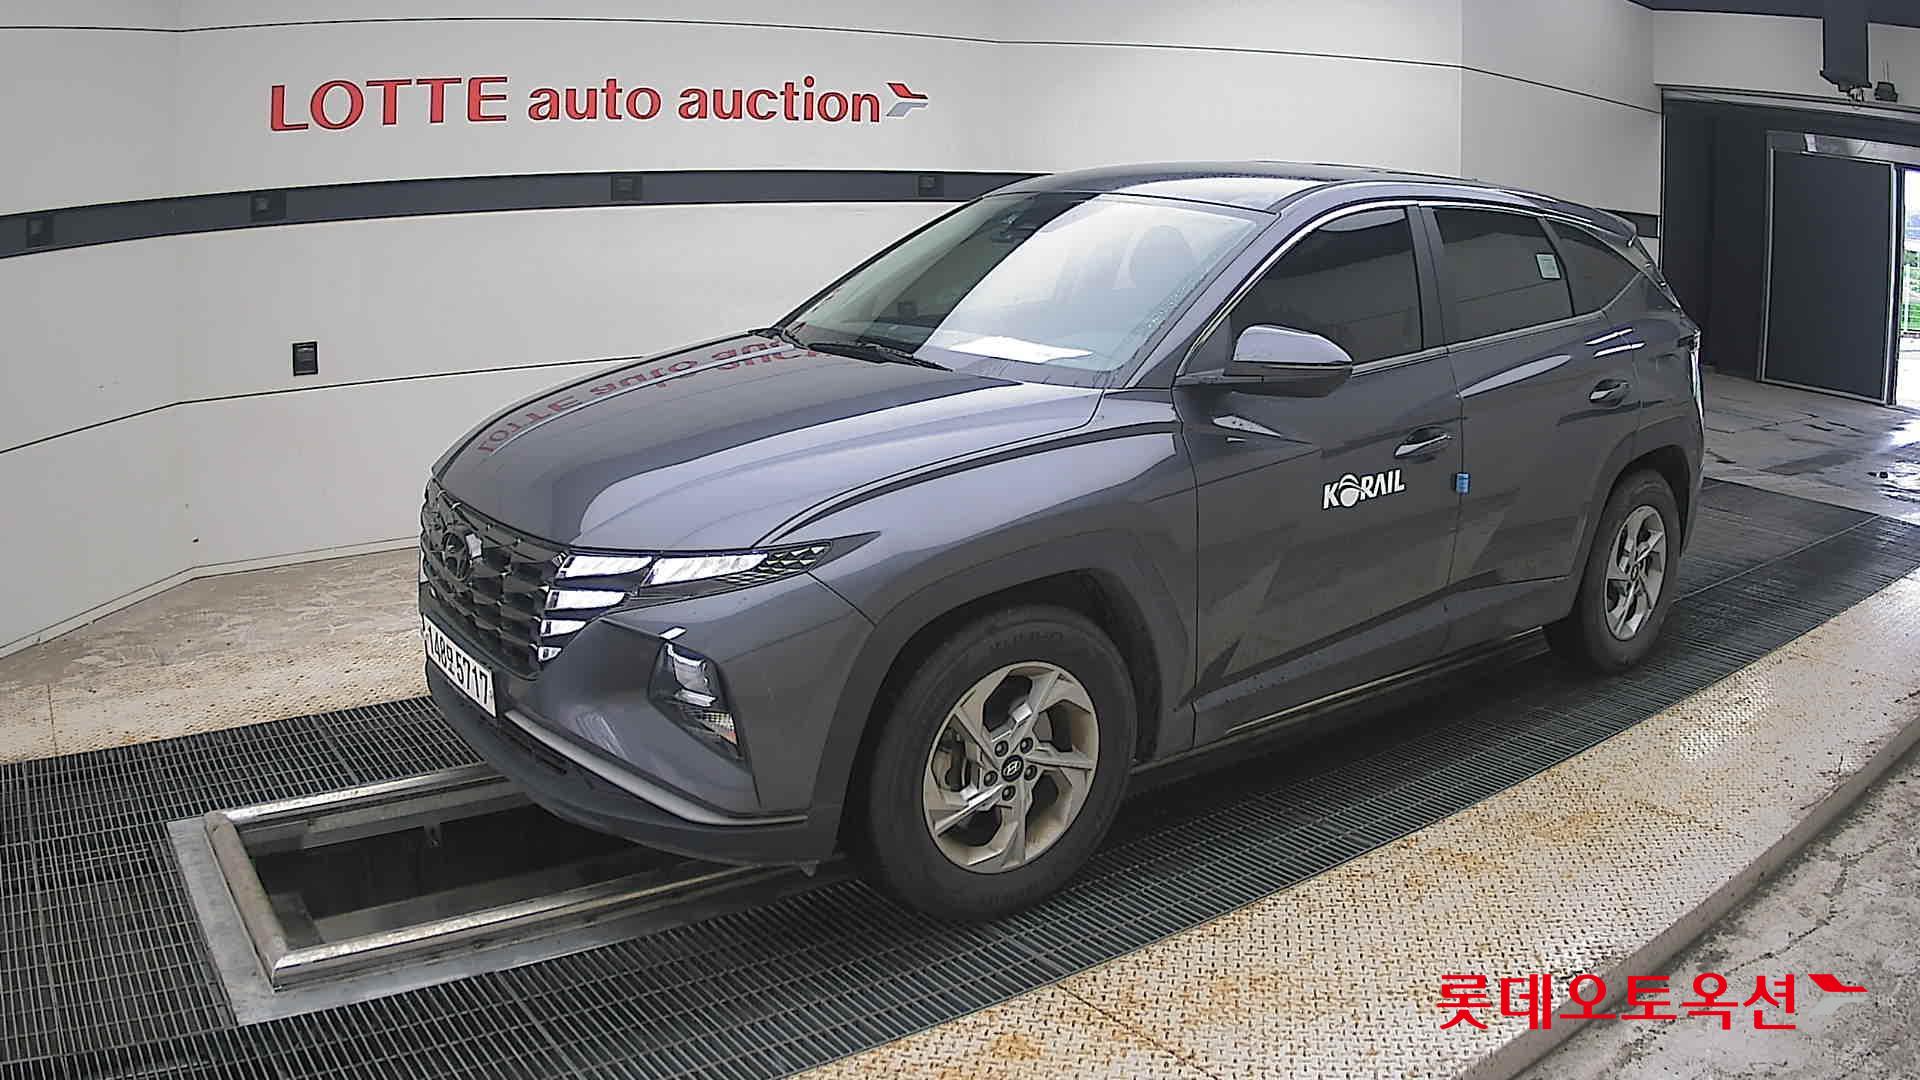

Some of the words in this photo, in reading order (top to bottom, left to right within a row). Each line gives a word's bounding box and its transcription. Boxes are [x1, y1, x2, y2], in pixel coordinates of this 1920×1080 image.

[269, 76, 508, 132] LOTTE
[527, 78, 662, 121] auto
[677, 75, 880, 122] auction
[1322, 468, 1406, 510] KORAIL
